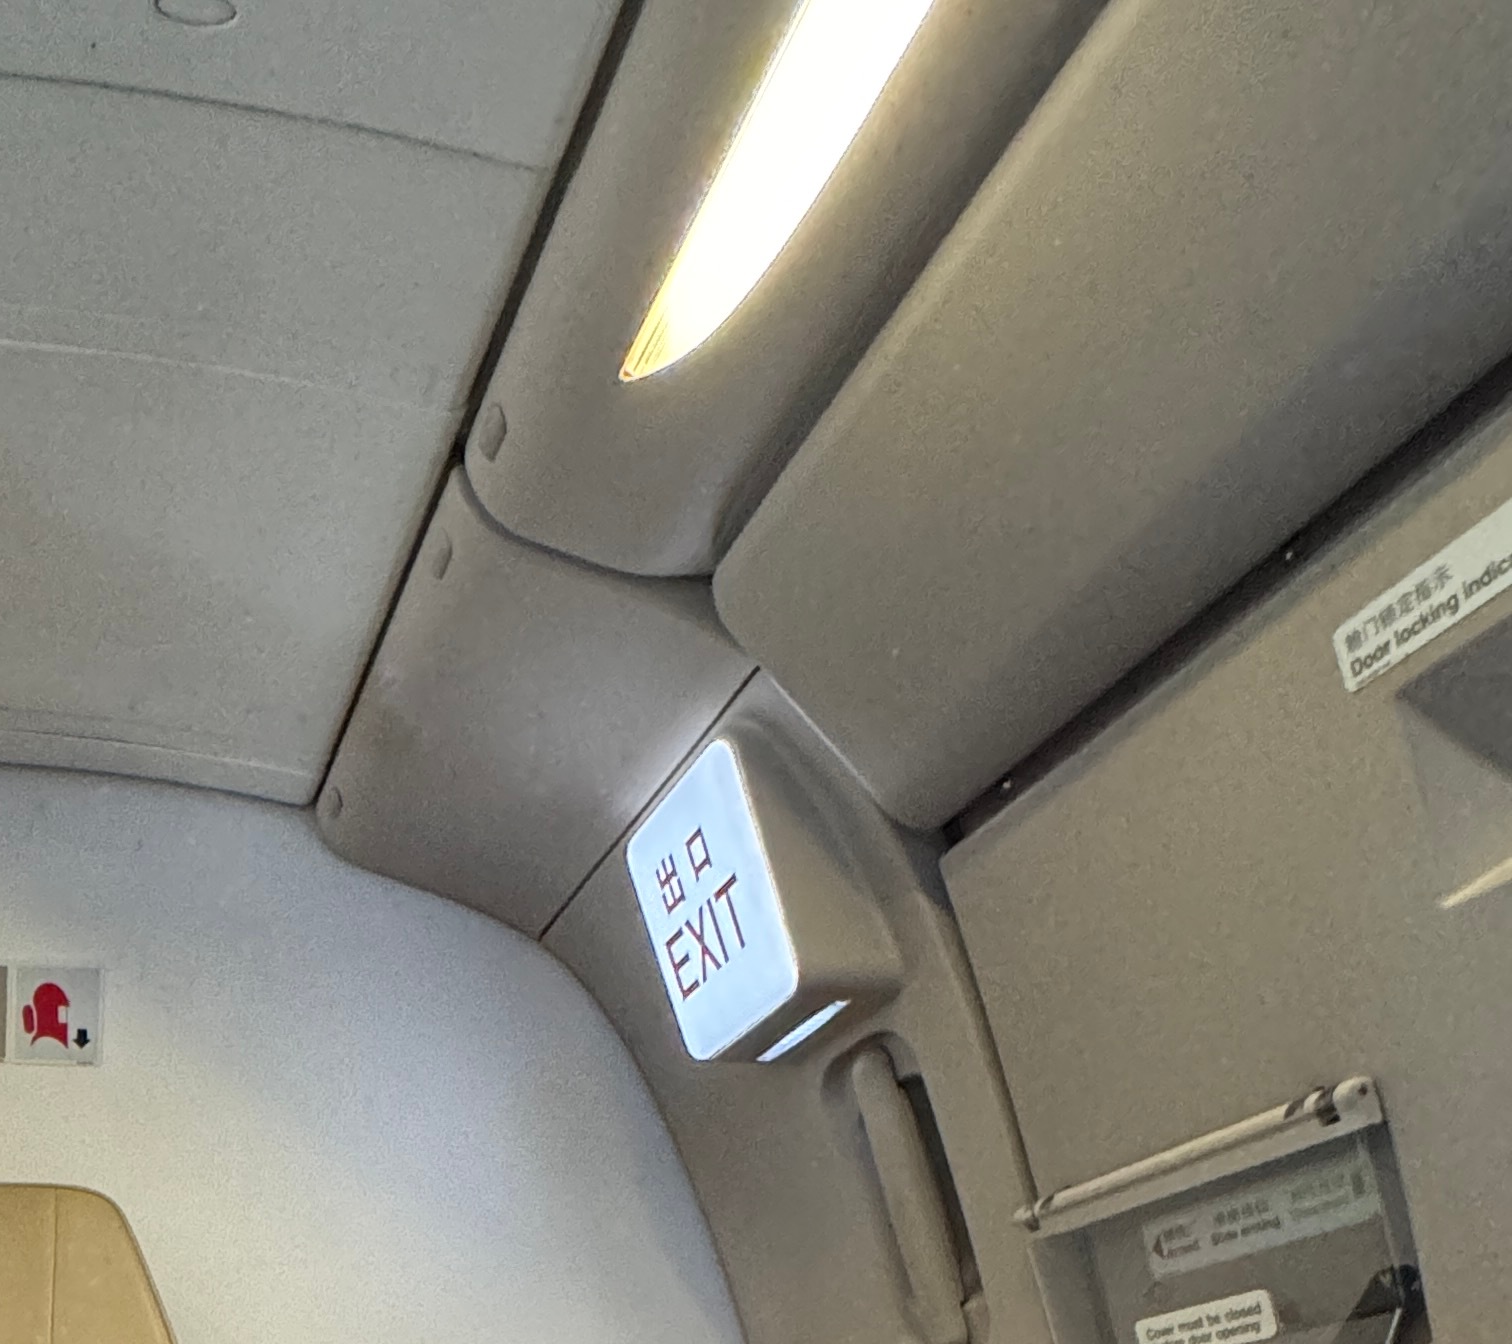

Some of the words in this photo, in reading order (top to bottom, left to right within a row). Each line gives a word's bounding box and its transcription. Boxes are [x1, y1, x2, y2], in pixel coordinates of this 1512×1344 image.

[1350, 639, 1391, 678] Door
[1393, 592, 1459, 648] locking
[1461, 553, 1512, 601] indic
[655, 825, 713, 915] 出口
[665, 872, 746, 1001] EXIT
[1146, 1323, 1175, 1341] Cover
[1206, 1313, 1221, 1327] be
[1224, 1301, 1262, 1322] closed
[1215, 1321, 1261, 1341] opening
